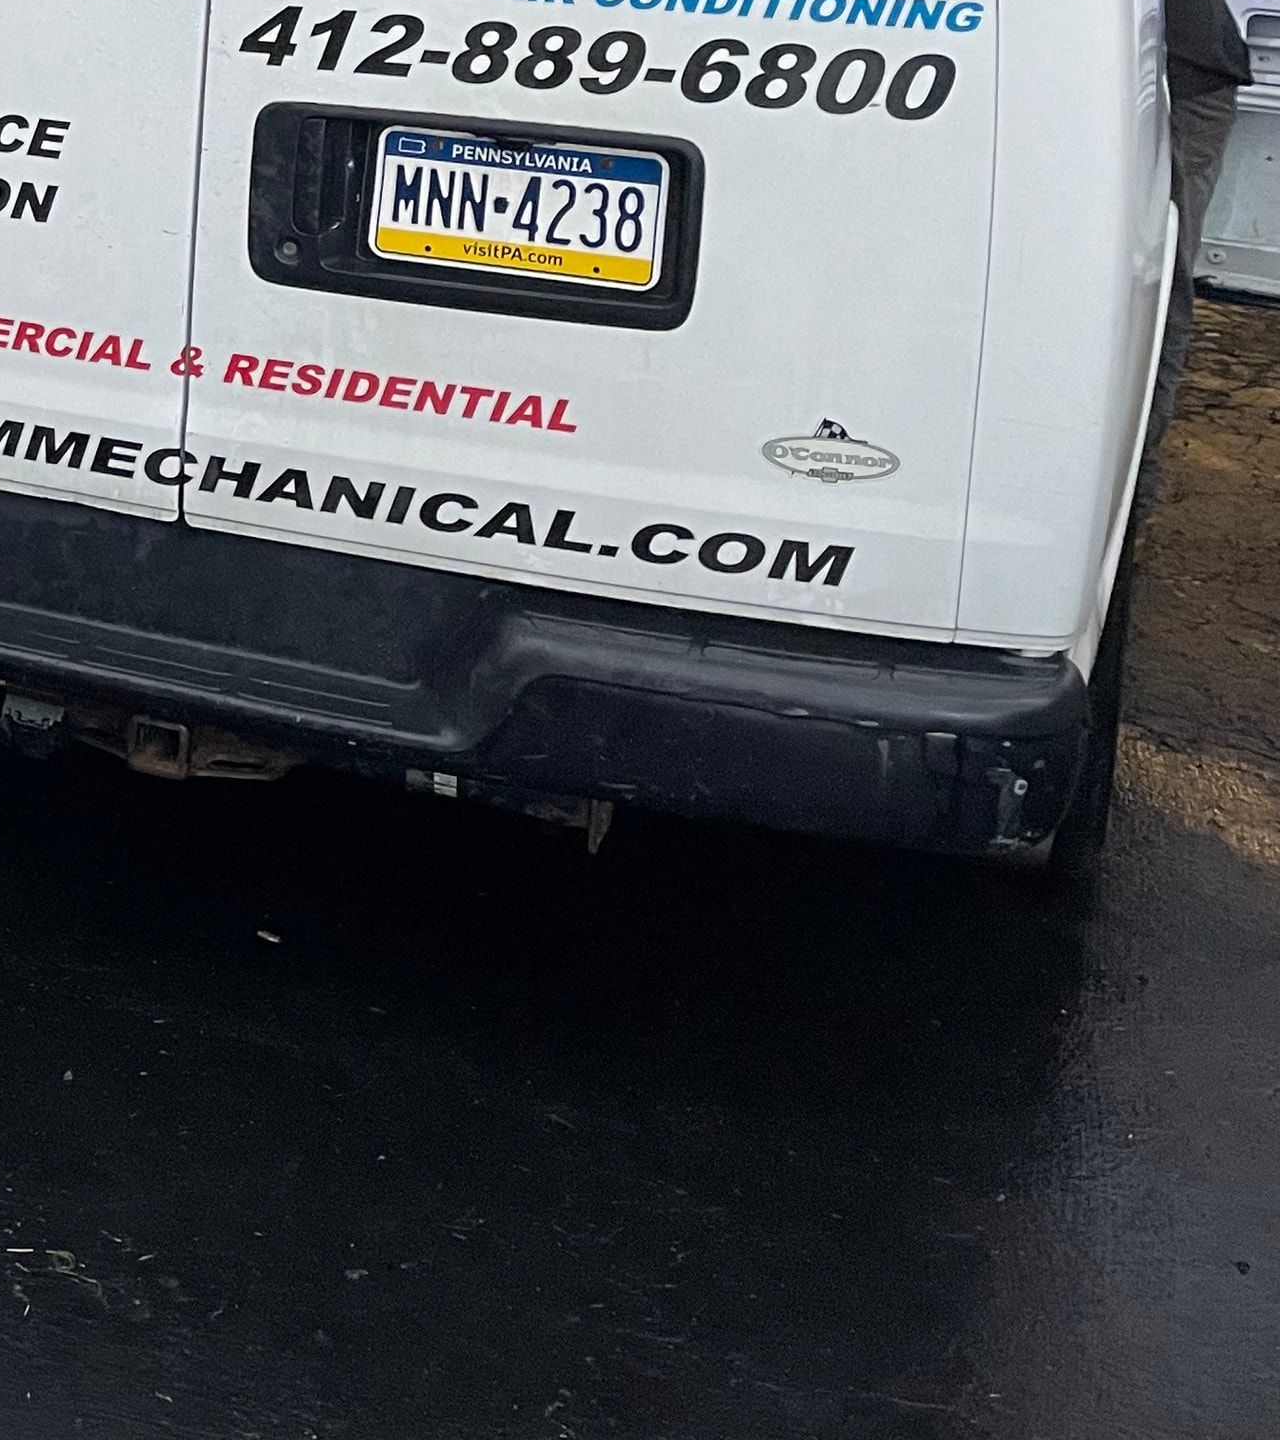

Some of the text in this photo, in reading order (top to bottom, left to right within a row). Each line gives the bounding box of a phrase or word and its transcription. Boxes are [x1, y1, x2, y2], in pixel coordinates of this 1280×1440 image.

[239, 5, 958, 122] 412-889-6800
[452, 143, 593, 174] PENNSYLVANIA
[392, 164, 645, 252] MNN-4238
[463, 243, 563, 267] visitPA.com
[170, 346, 206, 379] &
[222, 354, 578, 434] RESIDENTIAL
